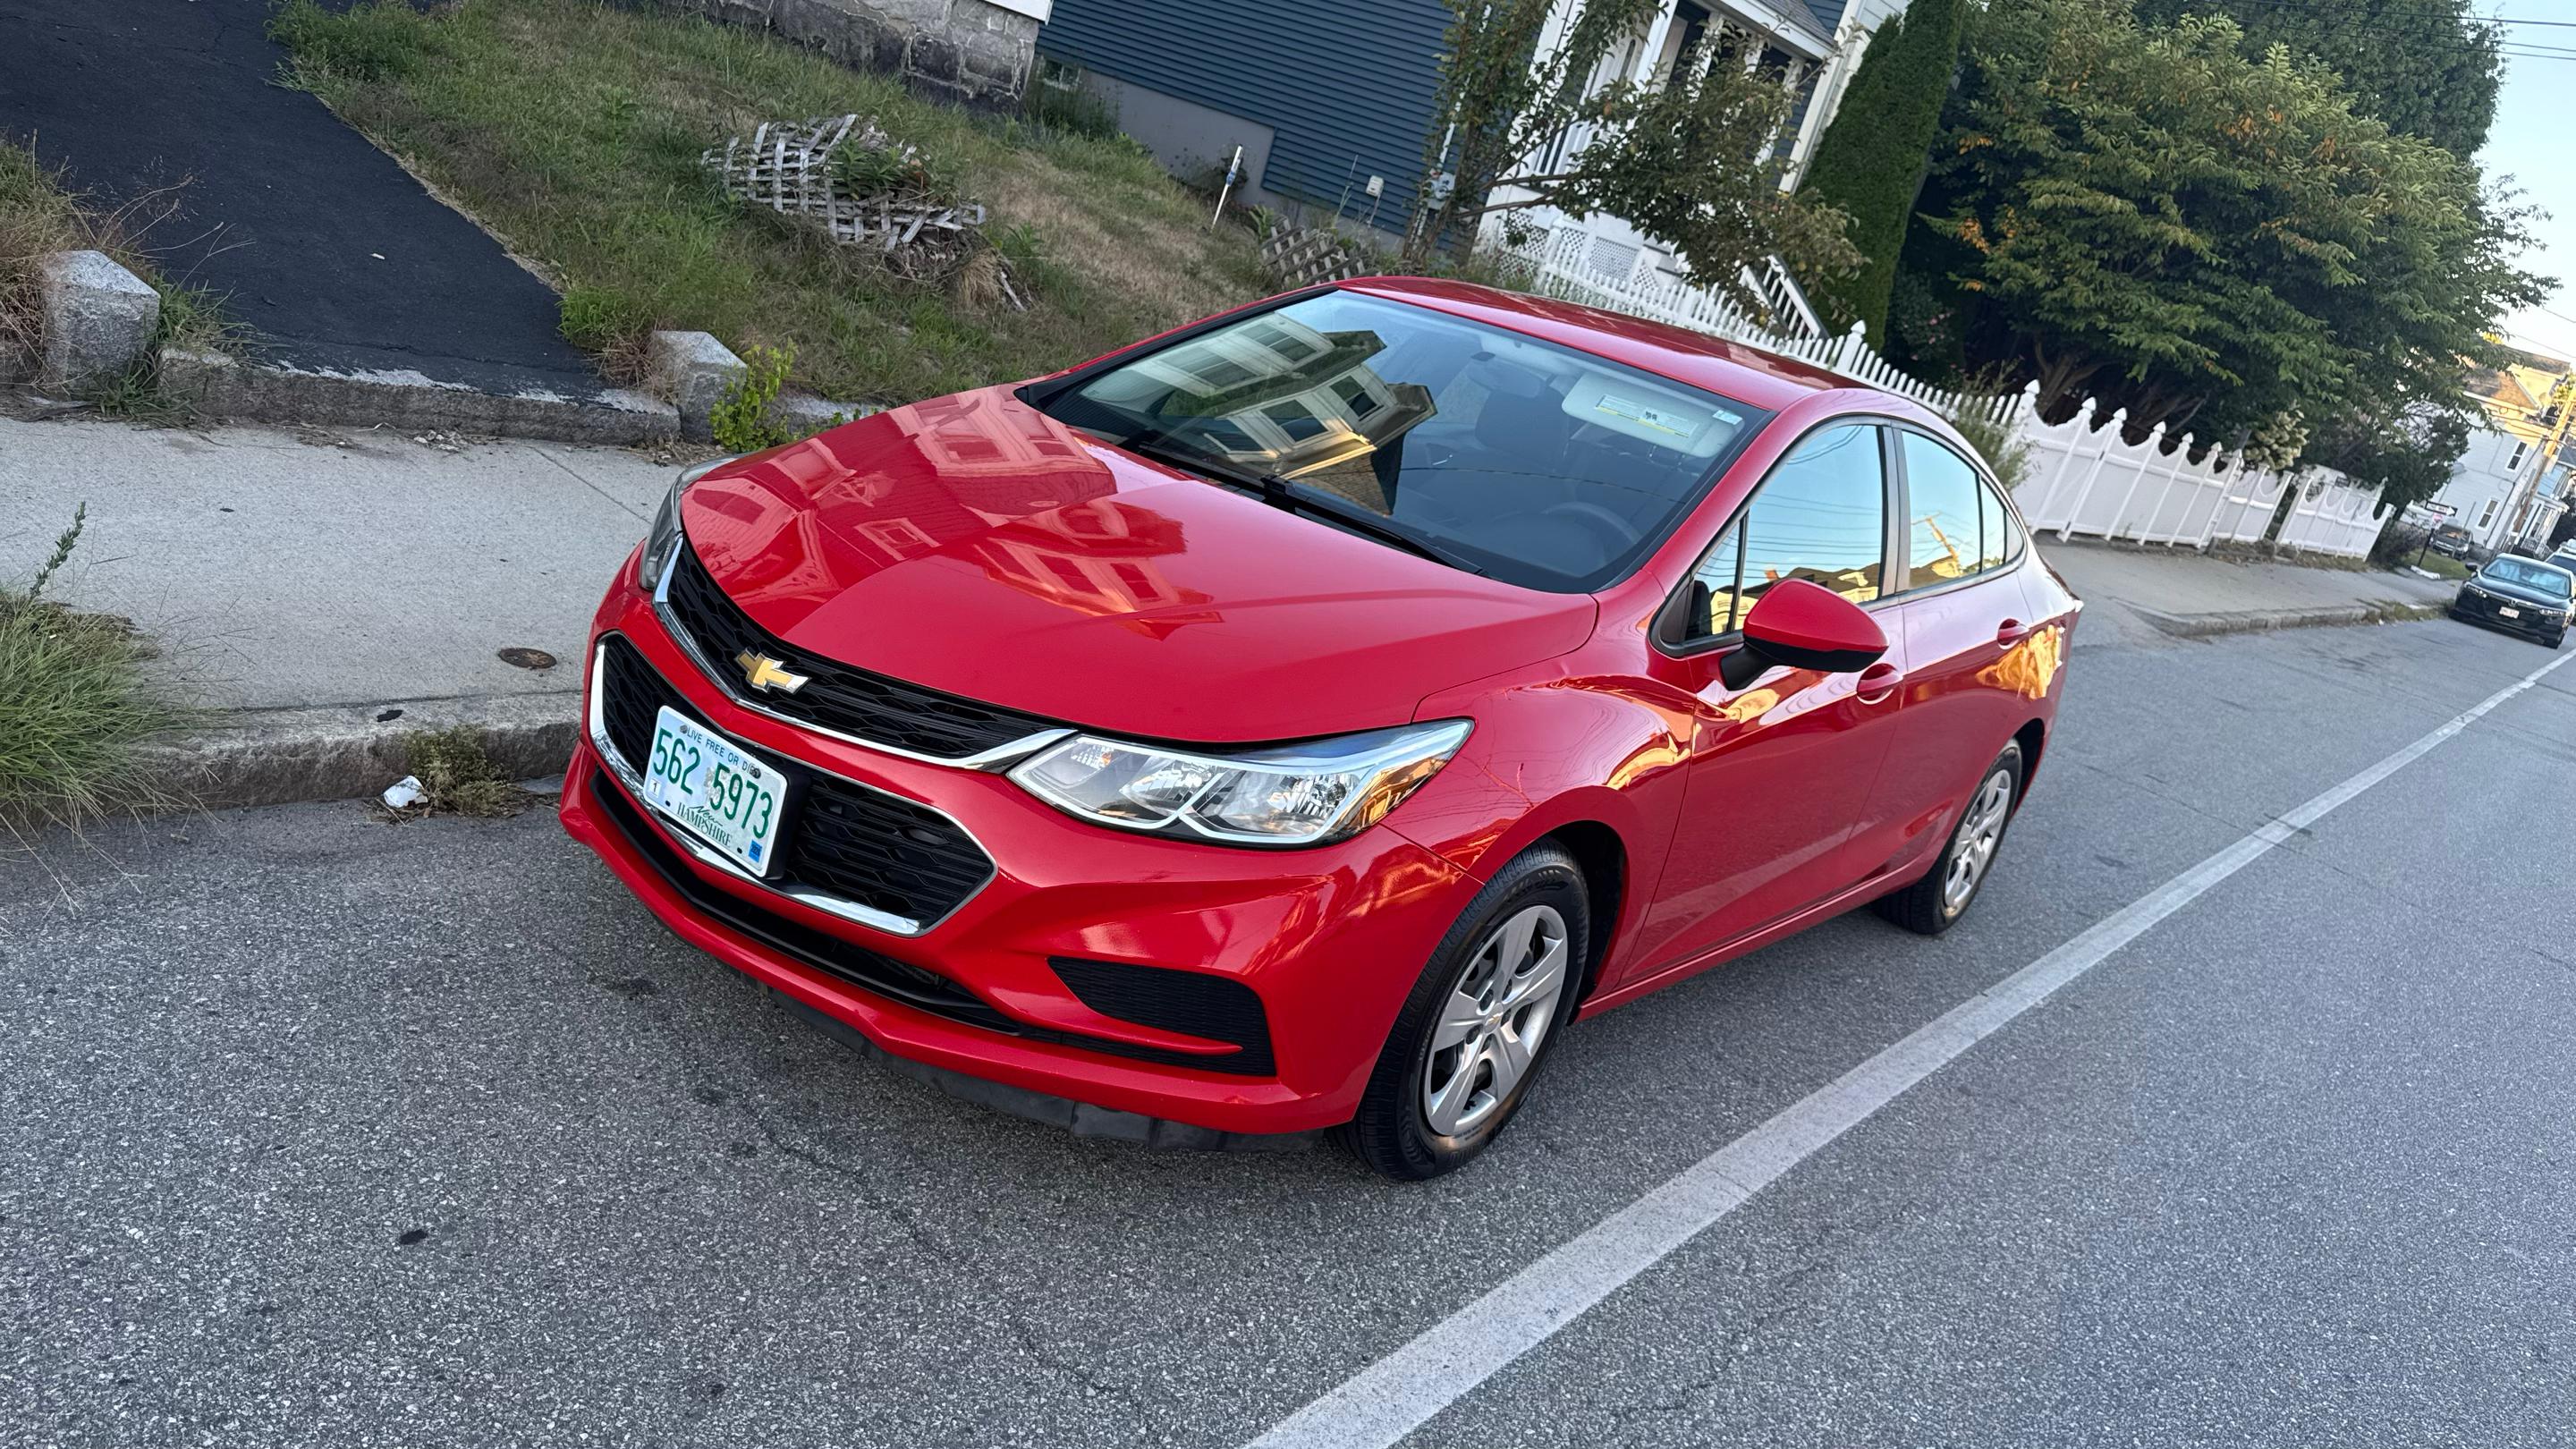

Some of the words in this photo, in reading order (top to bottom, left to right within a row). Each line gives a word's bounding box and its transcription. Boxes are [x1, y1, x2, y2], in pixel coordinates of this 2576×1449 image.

[687, 726, 703, 744] LIVE
[705, 738, 725, 758] FREE
[727, 752, 740, 767] OR
[653, 727, 701, 796] 562
[709, 762, 773, 839] 5973
[676, 801, 733, 847] HAMPSHIRE
[688, 805, 724, 827] New
